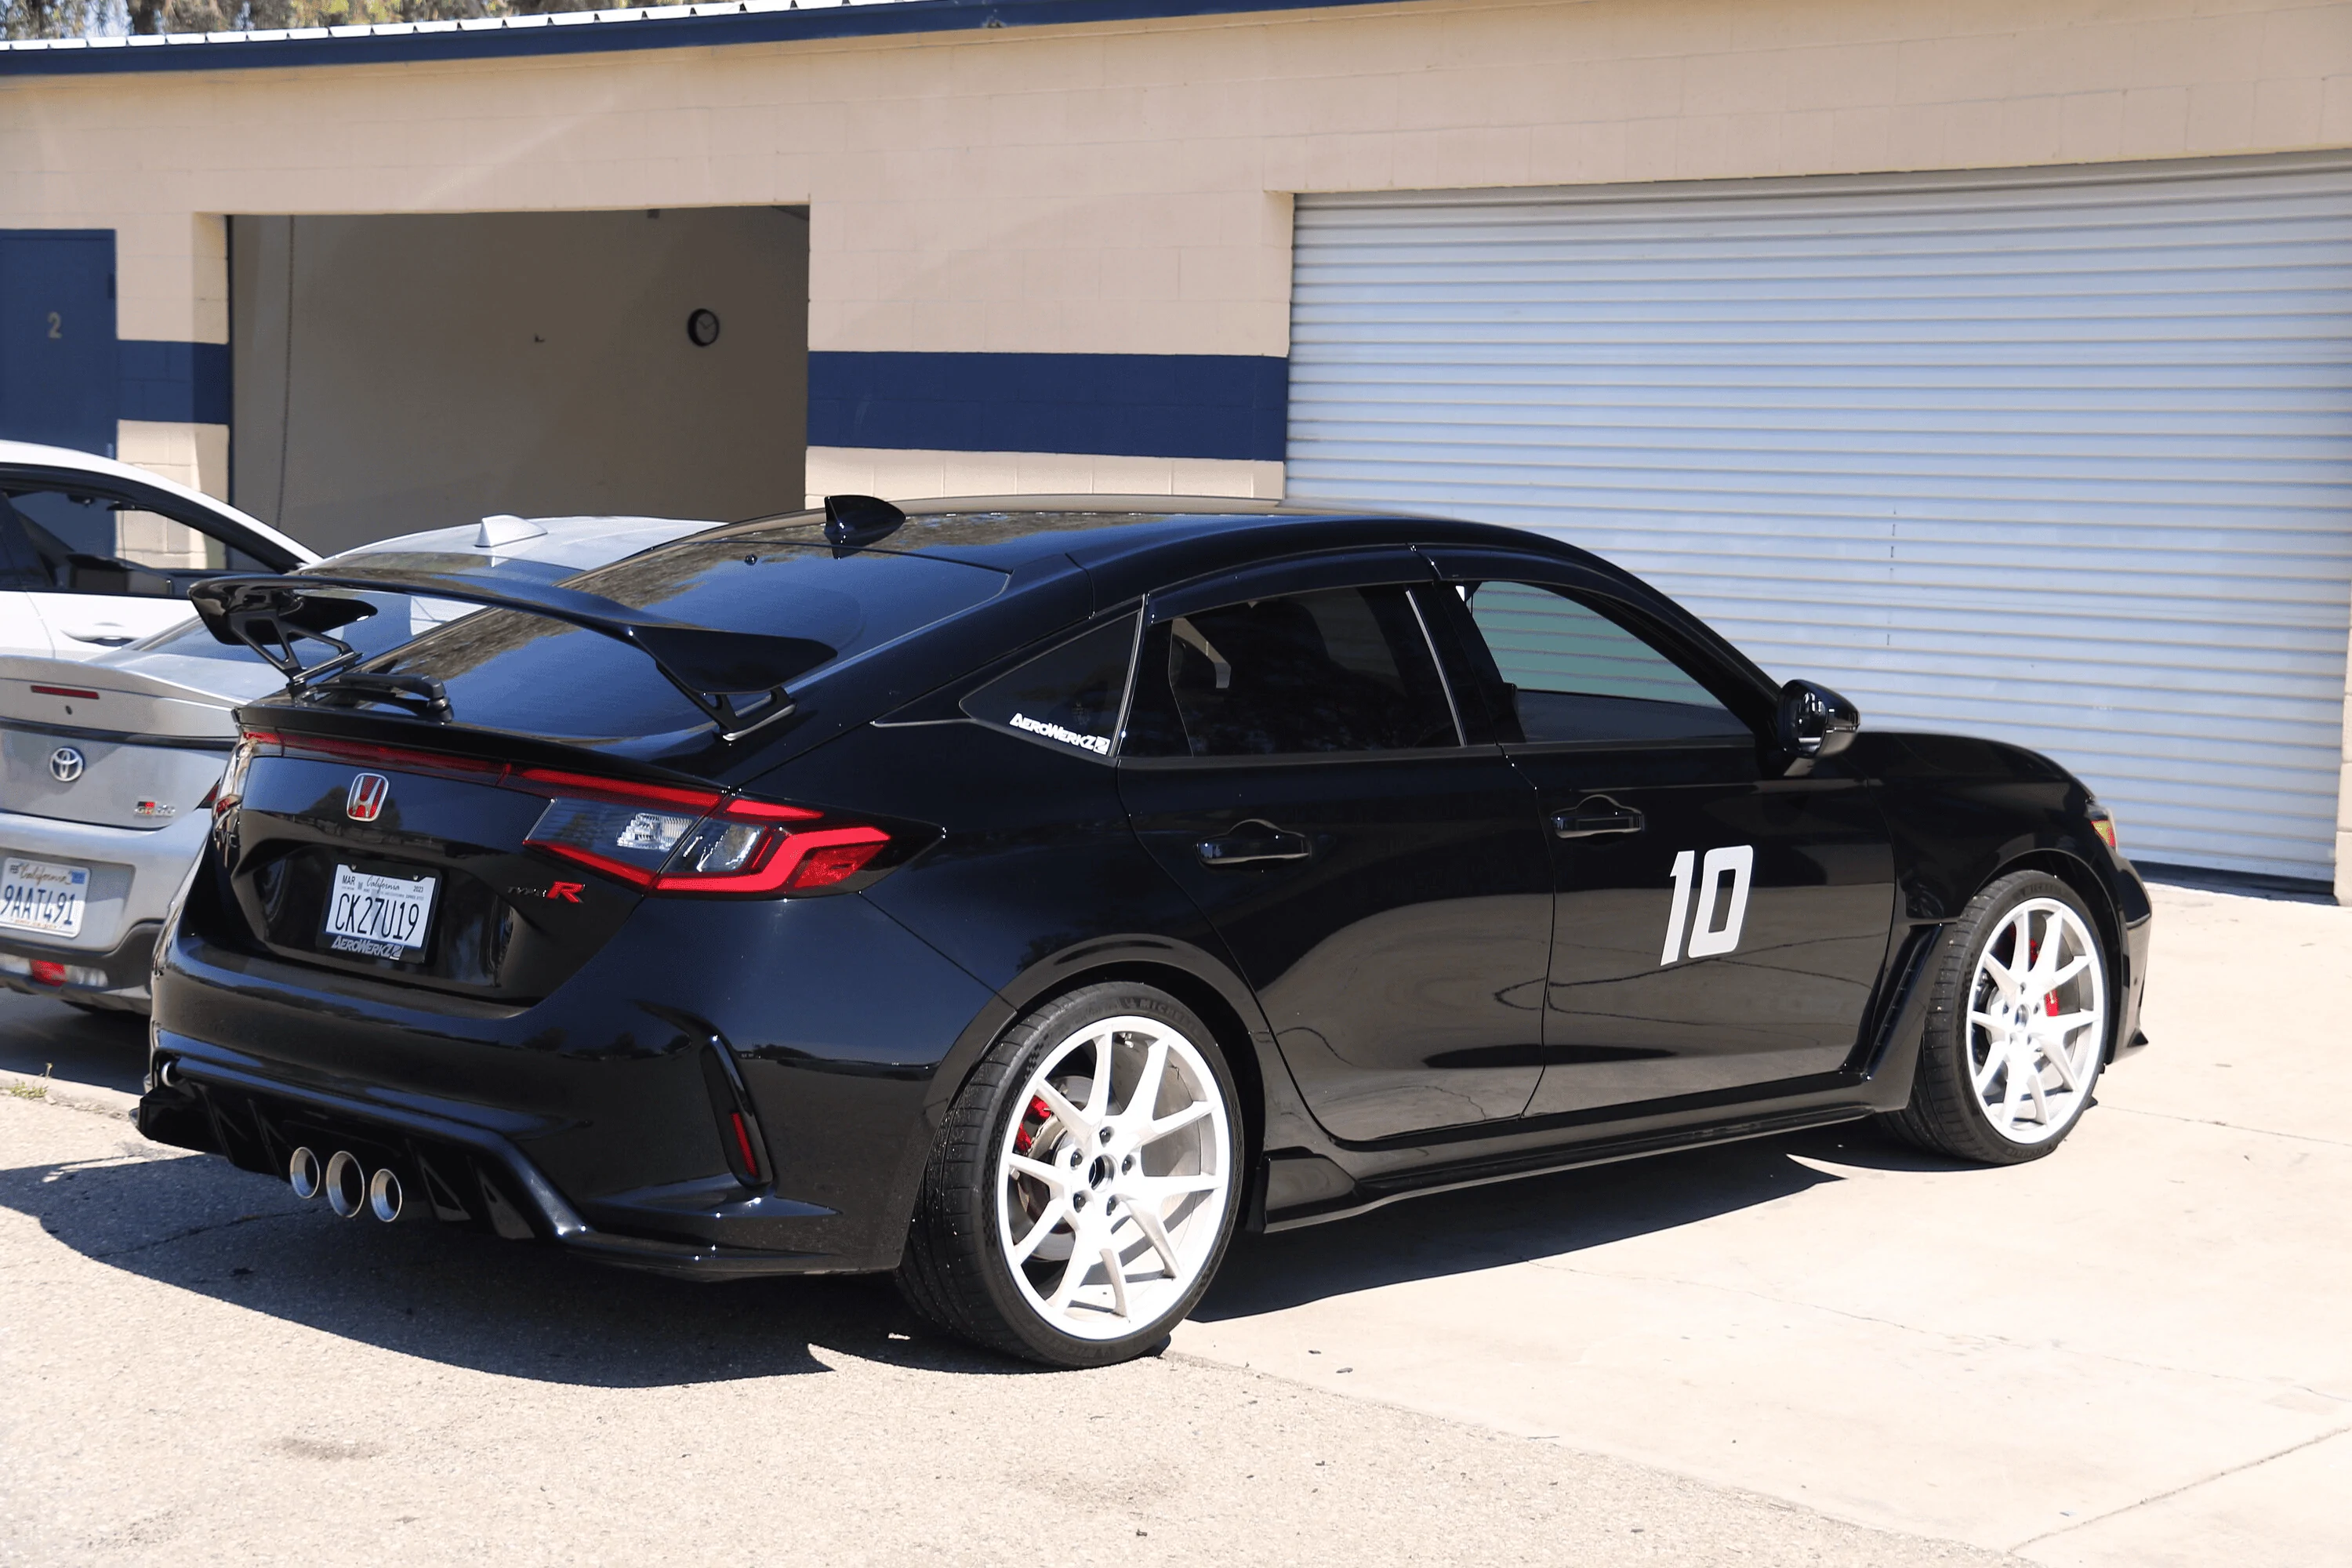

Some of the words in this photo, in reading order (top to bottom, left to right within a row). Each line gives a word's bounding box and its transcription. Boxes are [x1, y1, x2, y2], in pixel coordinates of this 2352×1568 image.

[48, 312, 62, 339] 2
[342, 875, 355, 886] MAR
[366, 876, 400, 894] California
[546, 880, 585, 903] R
[0, 884, 75, 925] 9AAT491
[335, 893, 419, 942] CK27U19
[1661, 844, 1754, 967] 10
